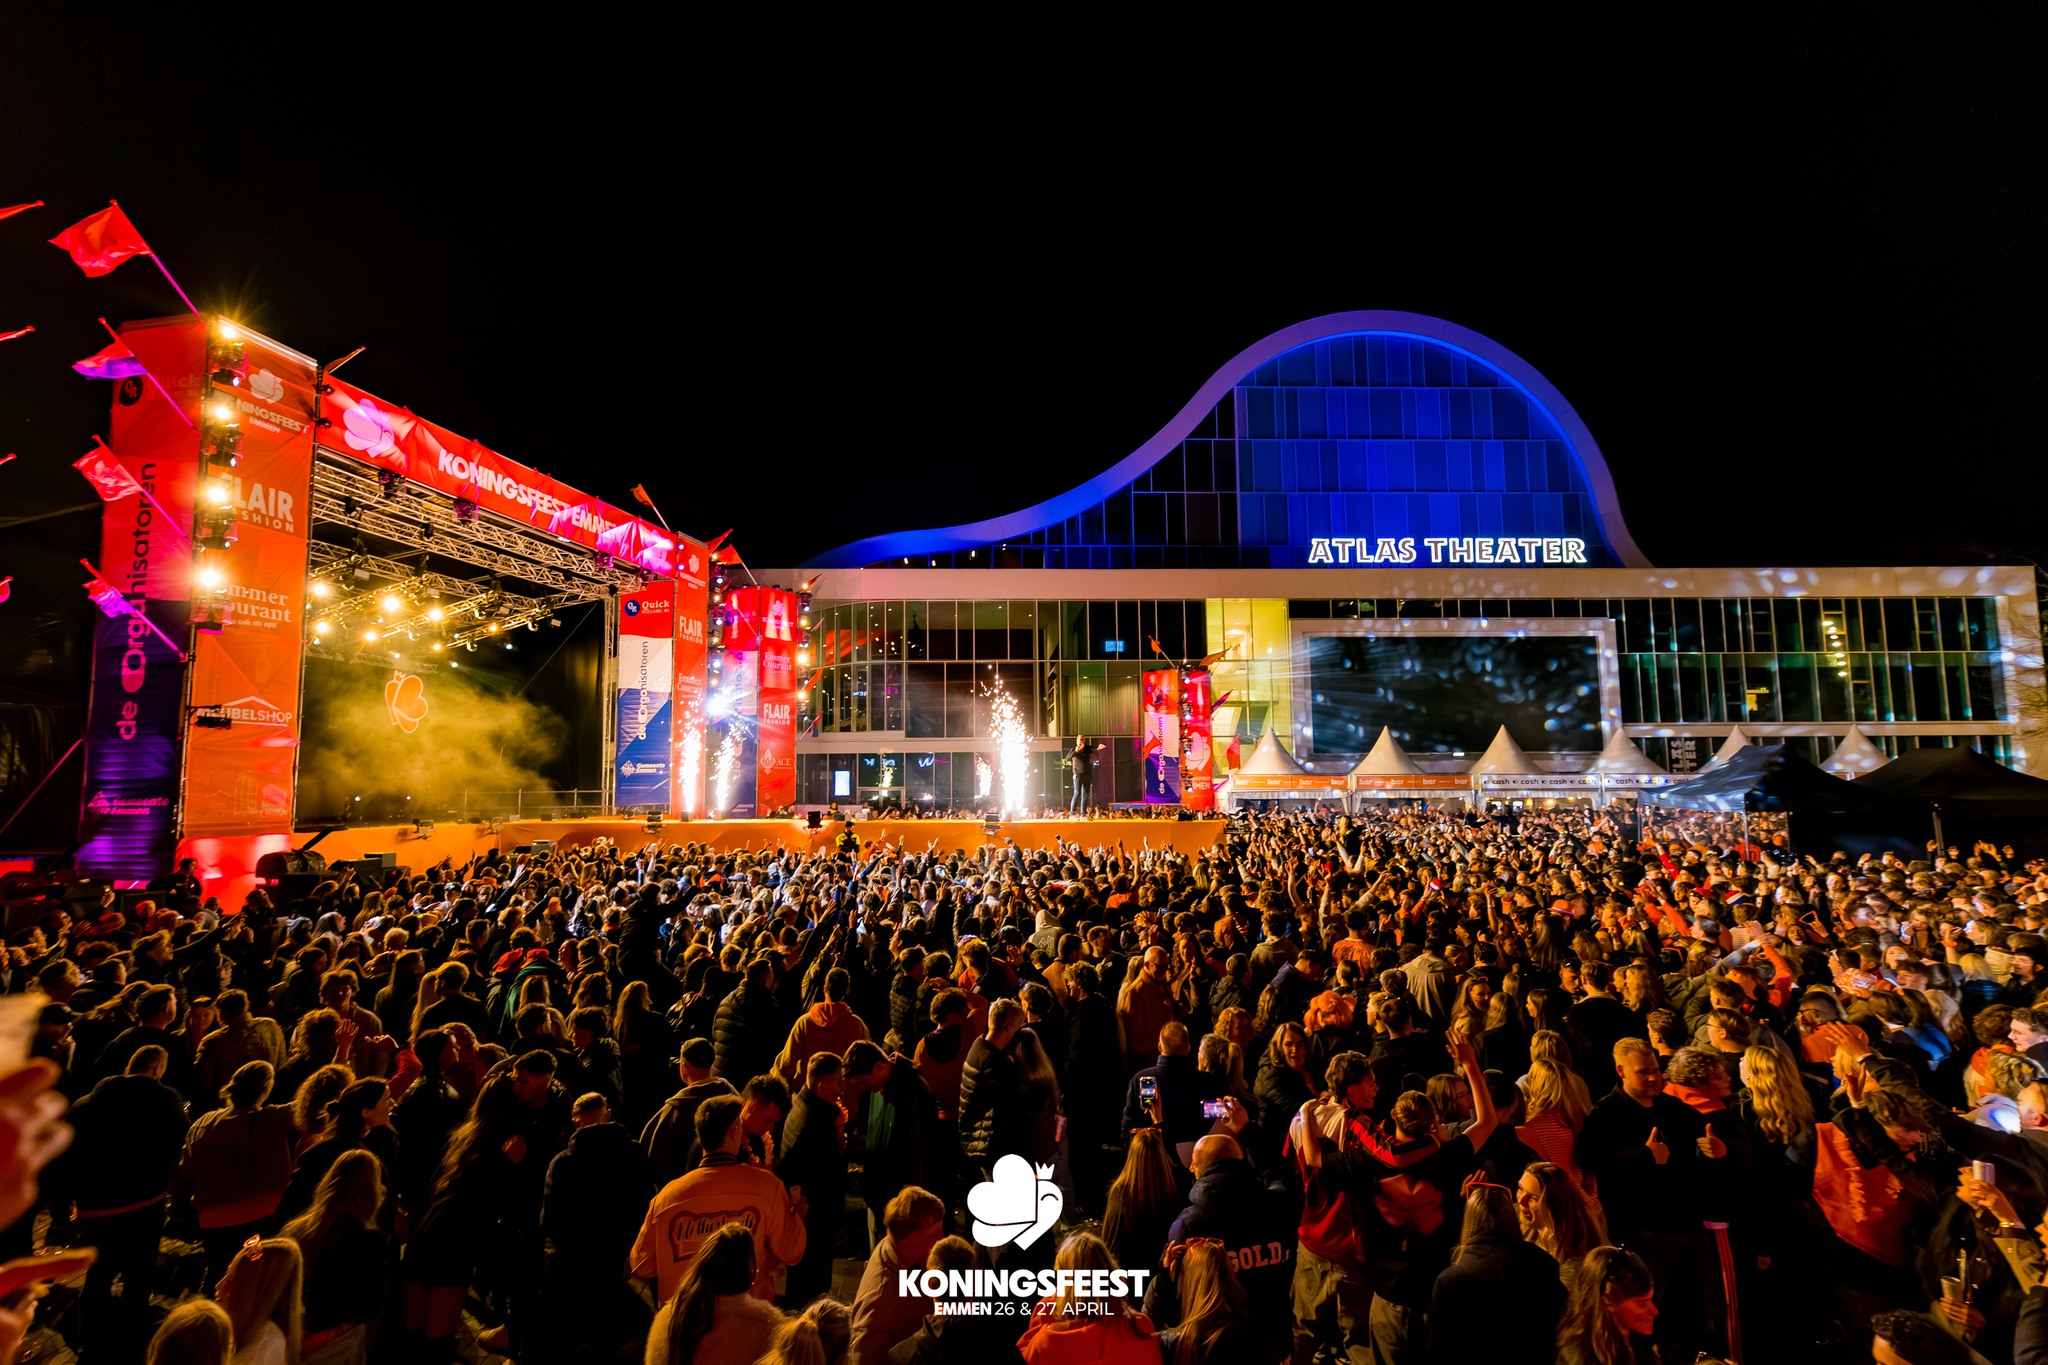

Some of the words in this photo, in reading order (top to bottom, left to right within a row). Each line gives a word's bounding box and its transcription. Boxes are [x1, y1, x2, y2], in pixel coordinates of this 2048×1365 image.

[438, 448, 571, 521] KONINGSFEEST
[1308, 537, 1418, 563] ATLAS
[1424, 537, 1587, 563] THEATER
[227, 584, 289, 607] mmer
[641, 599, 670, 611] Quick
[679, 615, 703, 638] FLAIR
[763, 661, 793, 671] Courant
[764, 652, 791, 662] Emmer
[637, 640, 650, 724] Organisatoren
[116, 701, 138, 740] de
[763, 703, 791, 720] FLAIR
[1236, 778, 1250, 786] bar
[1267, 778, 1281, 786] bar
[1299, 778, 1313, 786] bar
[1330, 777, 1345, 786] bar
[1454, 777, 1469, 785] bar
